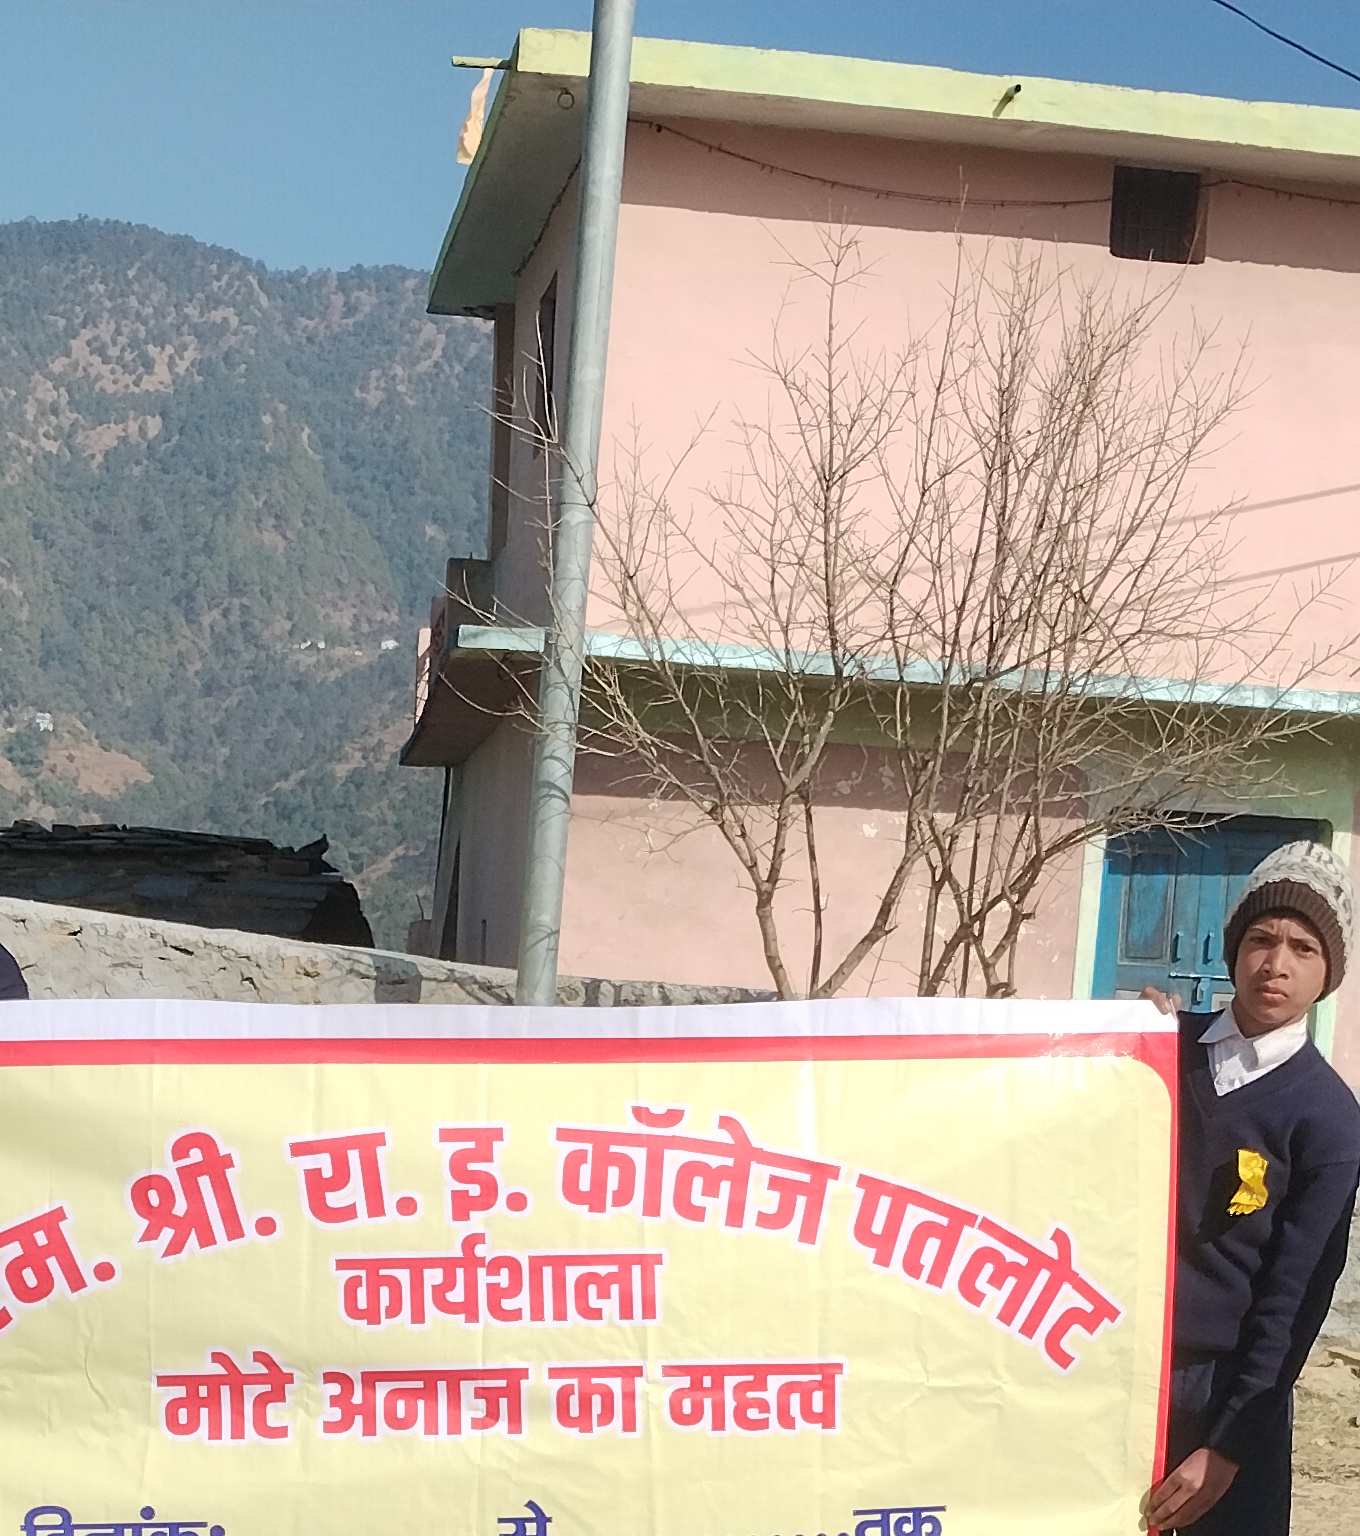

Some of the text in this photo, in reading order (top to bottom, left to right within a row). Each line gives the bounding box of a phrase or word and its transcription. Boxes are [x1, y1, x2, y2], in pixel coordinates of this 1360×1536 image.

[129, 1130, 279, 1258] श्री.
[288, 1131, 419, 1225] रा.
[438, 1126, 529, 1222] इ.
[555, 1105, 841, 1245] कॉलेज
[852, 1173, 1122, 1371] पतलोट
[334, 1231, 664, 1326] कार्यशाला
[155, 1350, 845, 1442] मोटे अनाज का महत्व
